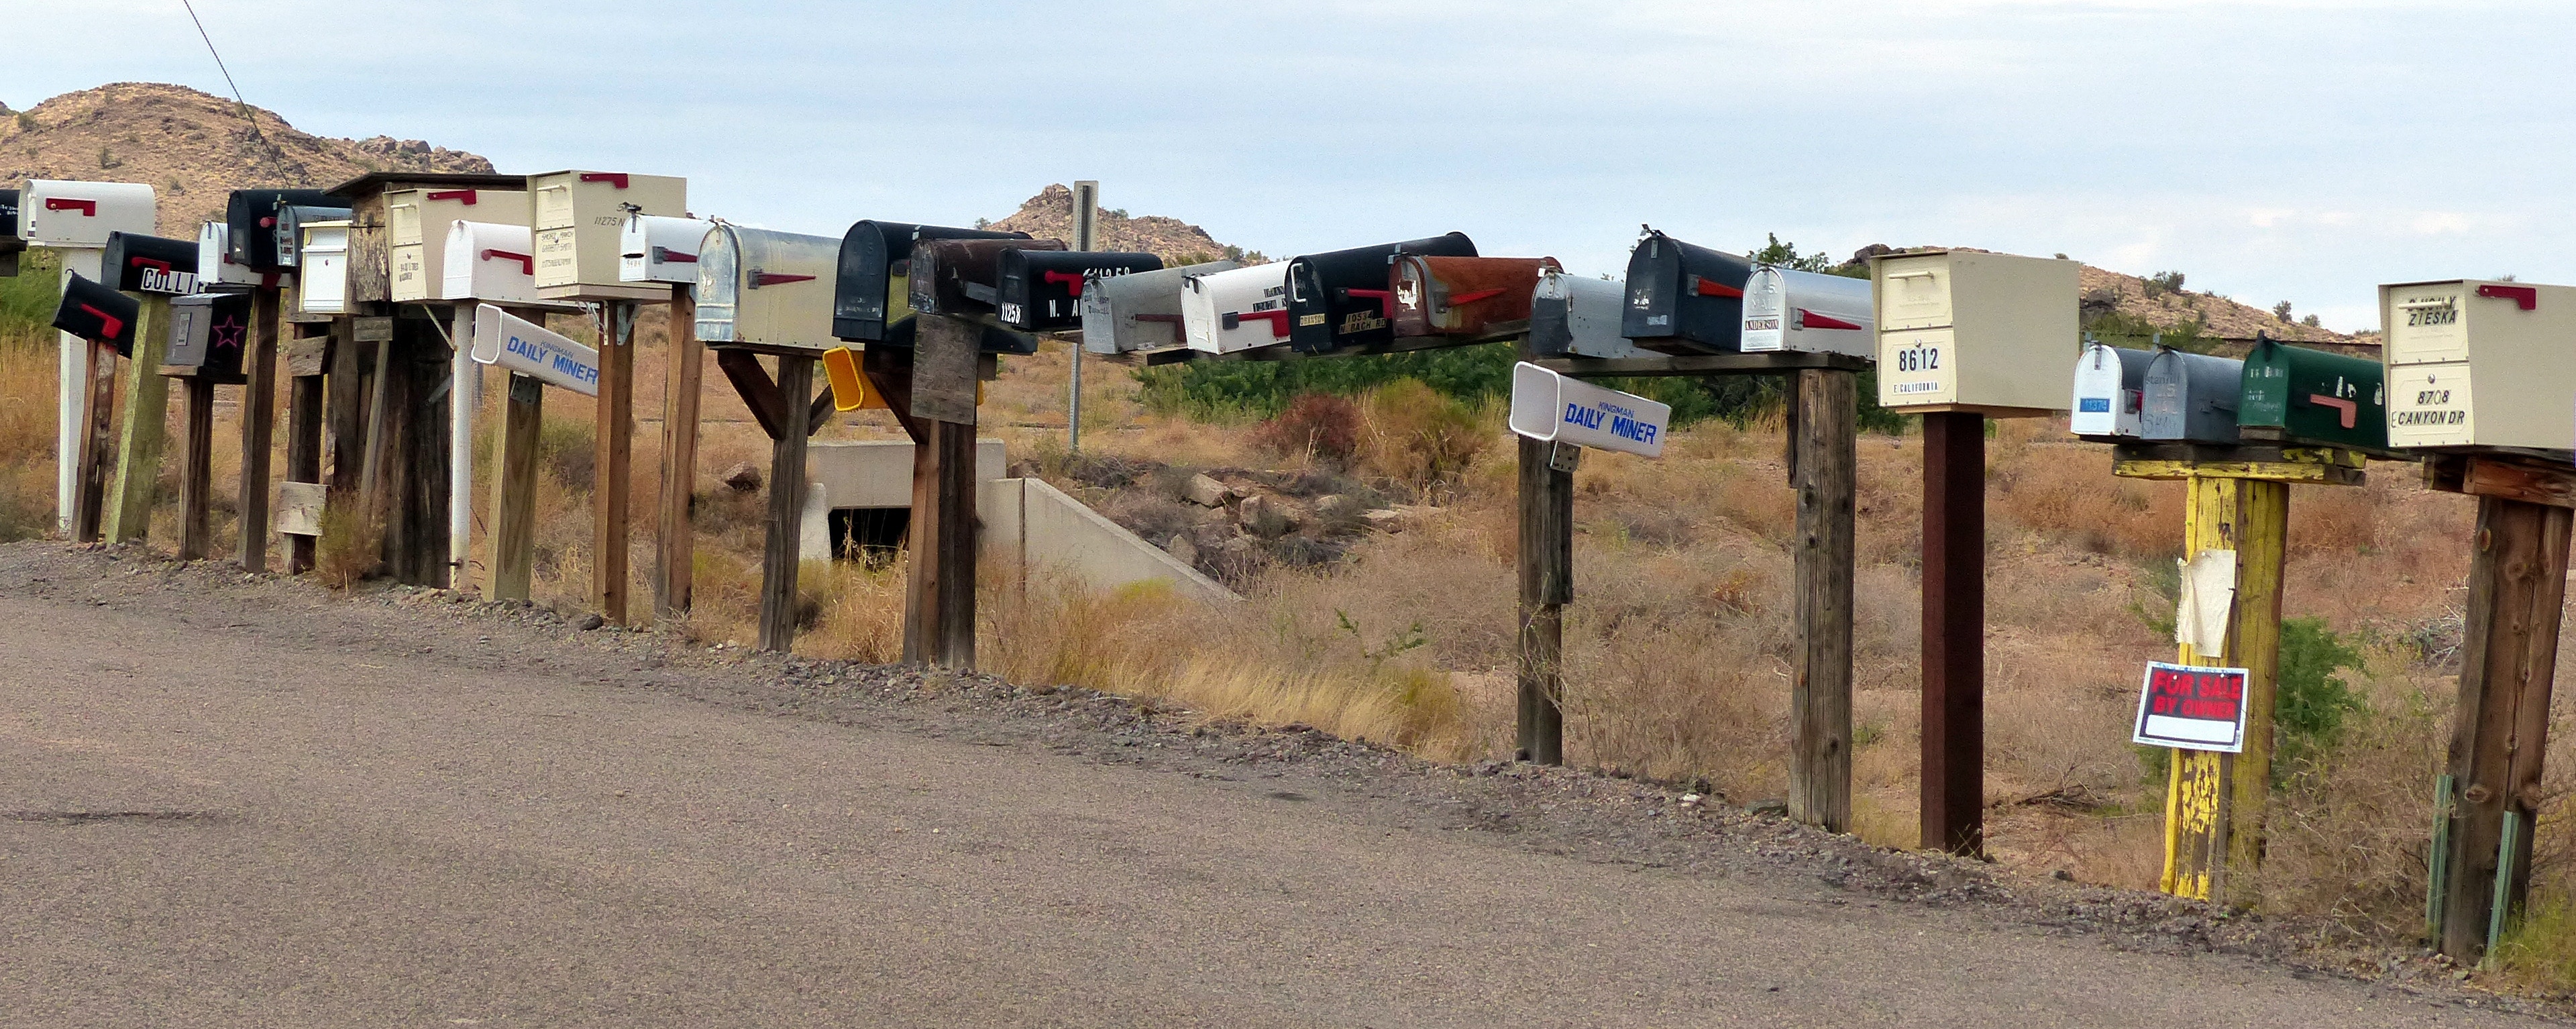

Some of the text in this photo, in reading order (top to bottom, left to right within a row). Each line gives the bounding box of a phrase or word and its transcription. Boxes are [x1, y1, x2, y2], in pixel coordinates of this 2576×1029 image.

[594, 215, 626, 227] 11275 N
[143, 269, 211, 294] COLLIE
[1001, 303, 1021, 324] 11258
[1071, 299, 1082, 317] A
[1347, 309, 1373, 322] 10534
[1375, 319, 1387, 327] RD
[1745, 319, 1779, 331] ANDERSON
[2408, 309, 2457, 326] ZIESKA
[507, 336, 598, 385] DAILY MINER
[1899, 347, 1938, 372] 8612
[1900, 382, 1938, 393] CALIFORNIA
[2418, 389, 2449, 405] 8708
[1599, 401, 1635, 419] KINGMAN
[1564, 402, 1657, 445] DAILY MINER
[2391, 411, 2465, 428] E CANYON DR
[2151, 670, 2243, 700] FOR SALE
[2152, 695, 2237, 719] BY OWNER
